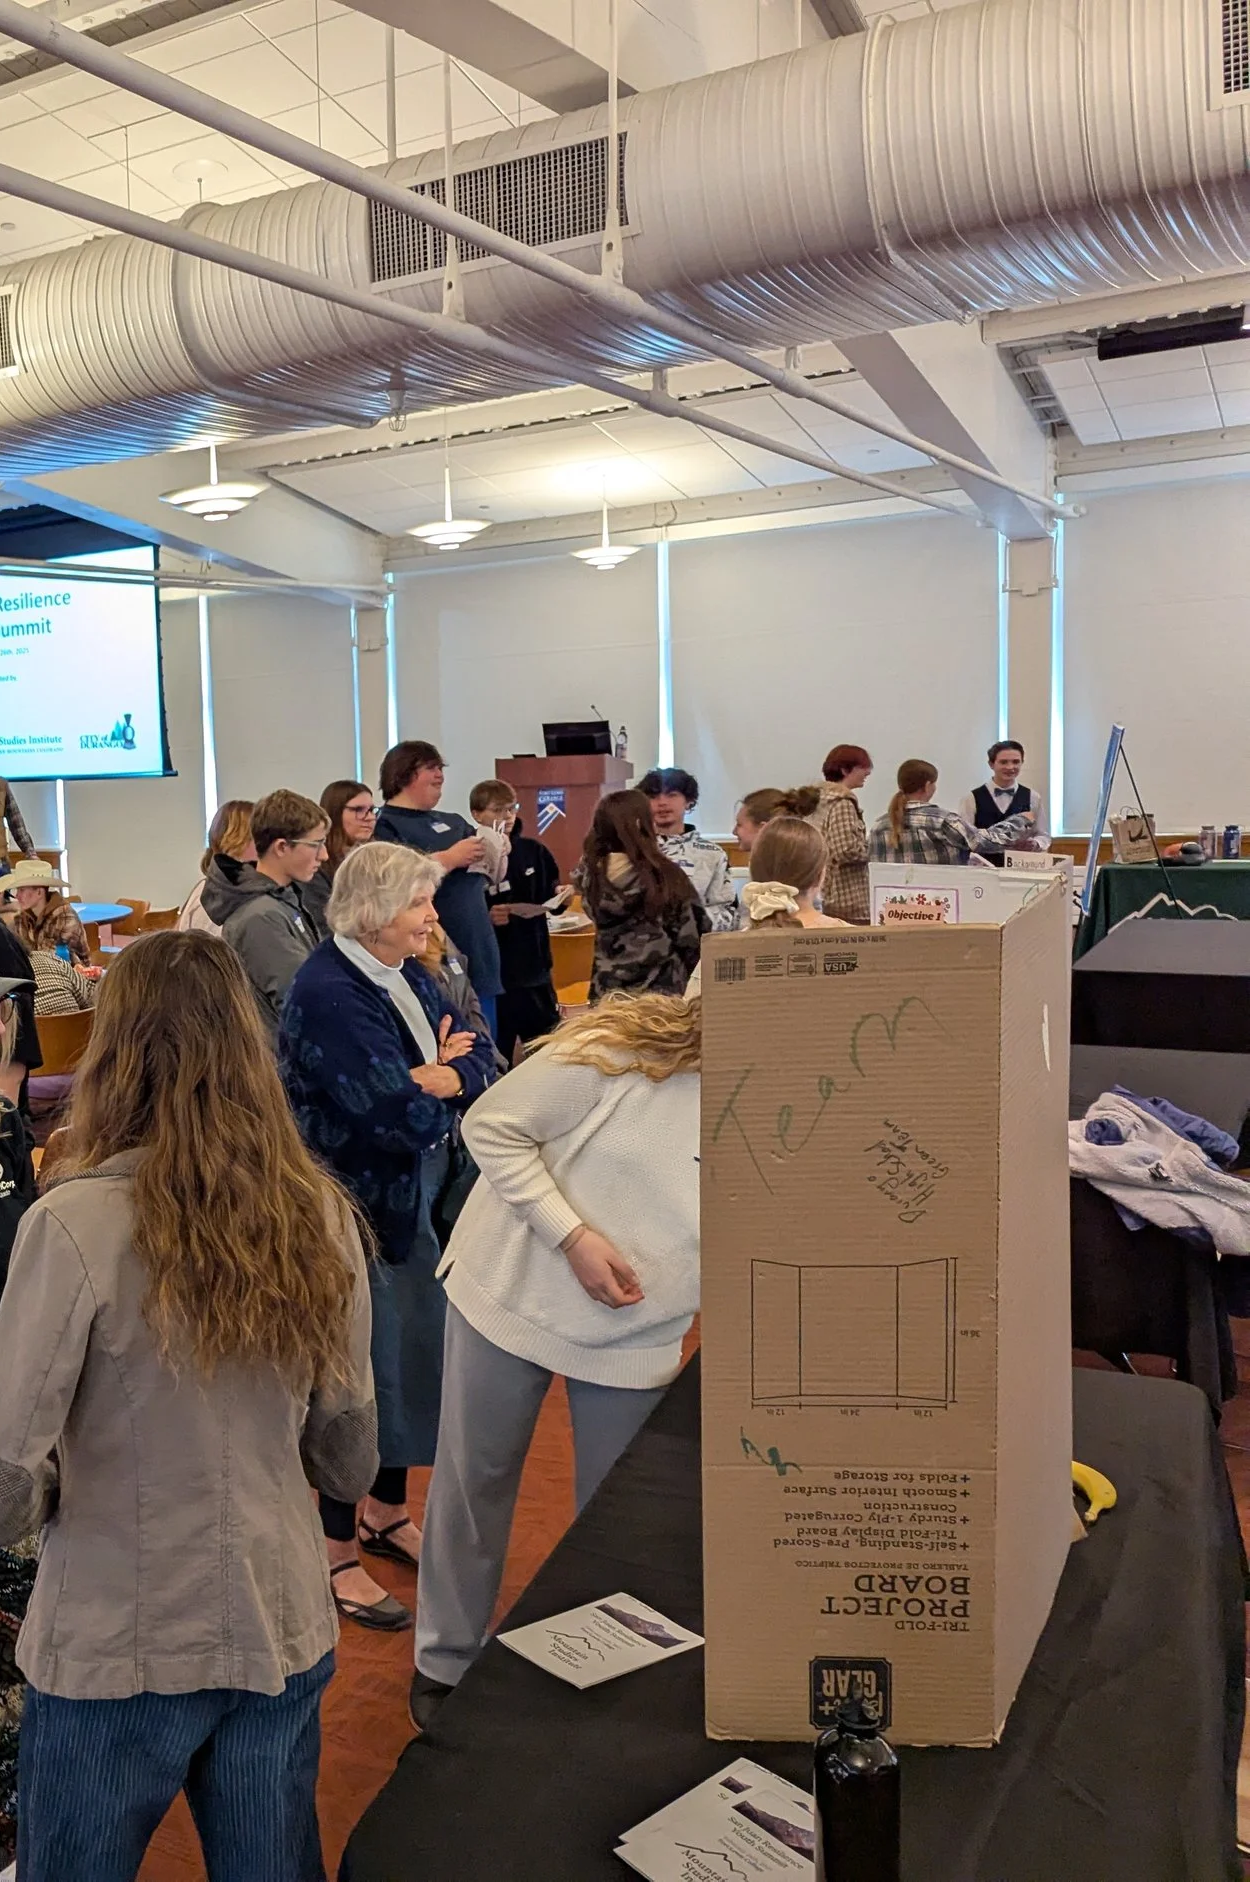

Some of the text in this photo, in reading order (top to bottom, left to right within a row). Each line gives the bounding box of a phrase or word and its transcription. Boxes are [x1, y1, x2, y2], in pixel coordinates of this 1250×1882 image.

[28, 735, 62, 744] Institute
[1006, 856, 1046, 868] Background
[888, 910, 941, 920] Objective 1
[825, 963, 847, 971] USA
[915, 1144, 949, 1179] Green
[834, 1471, 957, 1483] Folds for Storage
[783, 1486, 957, 1498] Smooth Interior Surface
[863, 1502, 957, 1512] Construction
[785, 1511, 957, 1524] Sturdy 1-Ply Corrugated
[797, 1527, 957, 1539] Tri-Fold Display Board
[773, 1538, 957, 1550] Self-Standing, Pre-Scored
[844, 1561, 903, 1569] PROYECTOS
[922, 1562, 968, 1570] TABLERO
[854, 1574, 970, 1595] BOARD
[820, 1596, 970, 1618] PROJECT
[895, 1620, 970, 1632] TRI-FOLD
[550, 1635, 588, 1660] Mountain
[550, 1643, 578, 1661] Studies
[548, 1650, 582, 1669] Institute
[728, 1816, 743, 1828] San
[743, 1827, 762, 1842] Juan
[762, 1840, 804, 1869] Resilience
[732, 1827, 756, 1847] Youth
[755, 1845, 788, 1868] Summit
